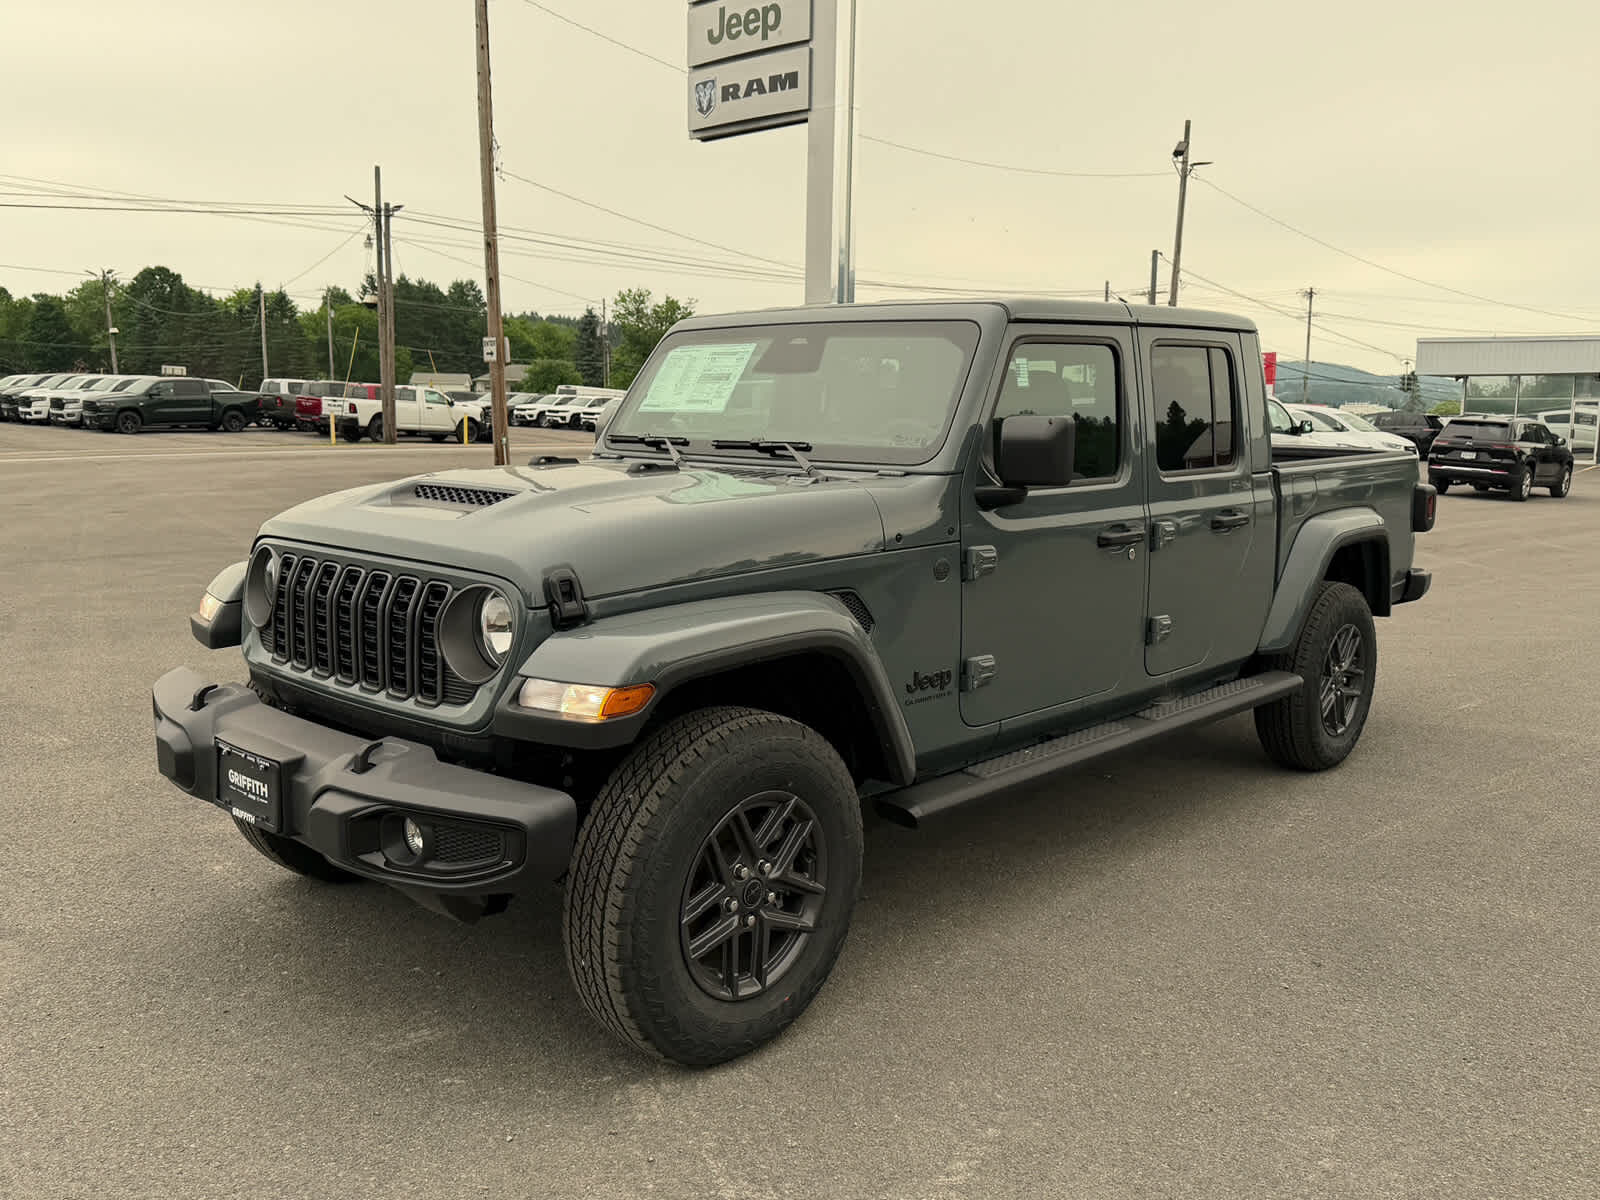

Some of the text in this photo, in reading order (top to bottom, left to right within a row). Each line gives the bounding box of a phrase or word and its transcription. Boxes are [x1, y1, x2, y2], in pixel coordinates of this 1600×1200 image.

[707, 3, 782, 45] Jeep
[721, 71, 799, 103] RAM
[906, 670, 952, 693] Jeep
[228, 769, 269, 799] GRIFFITH
[232, 807, 256, 825] GRIFFITH
